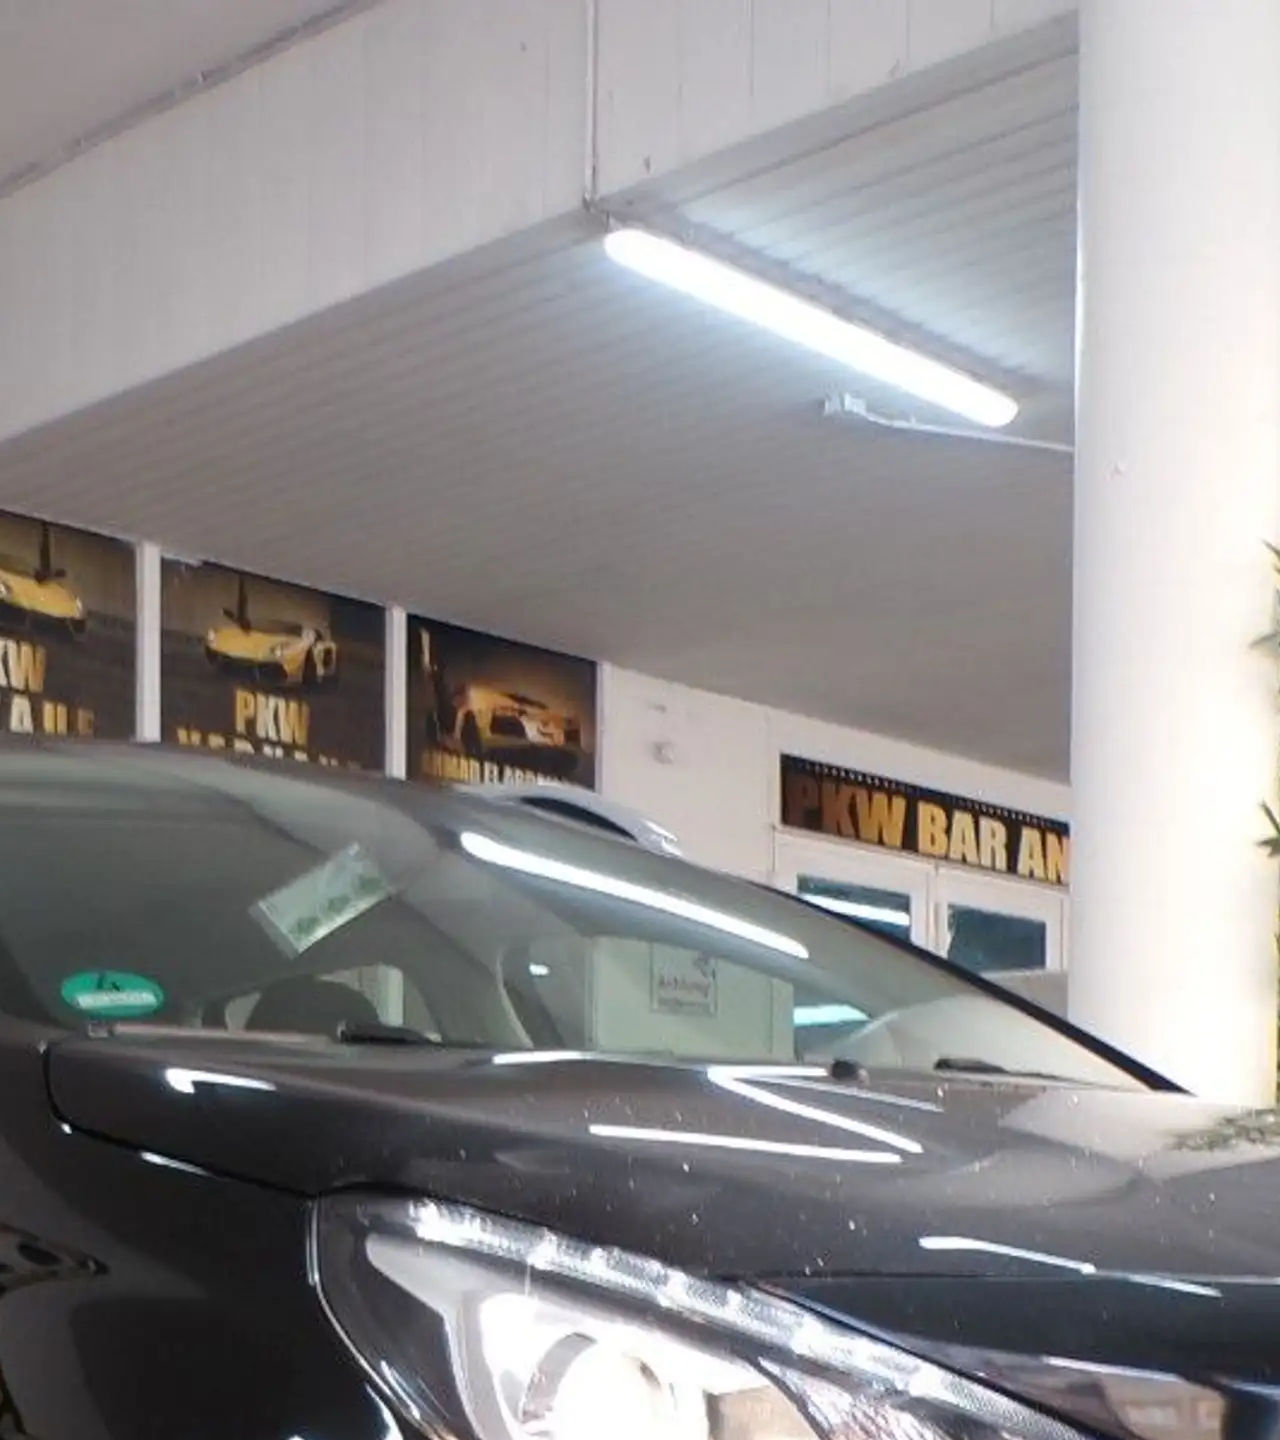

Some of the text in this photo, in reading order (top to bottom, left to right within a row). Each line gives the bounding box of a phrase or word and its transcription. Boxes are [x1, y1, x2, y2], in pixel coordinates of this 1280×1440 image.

[235, 687, 311, 747] PKW
[783, 772, 908, 850] PKW
[918, 800, 1008, 873] BAR
